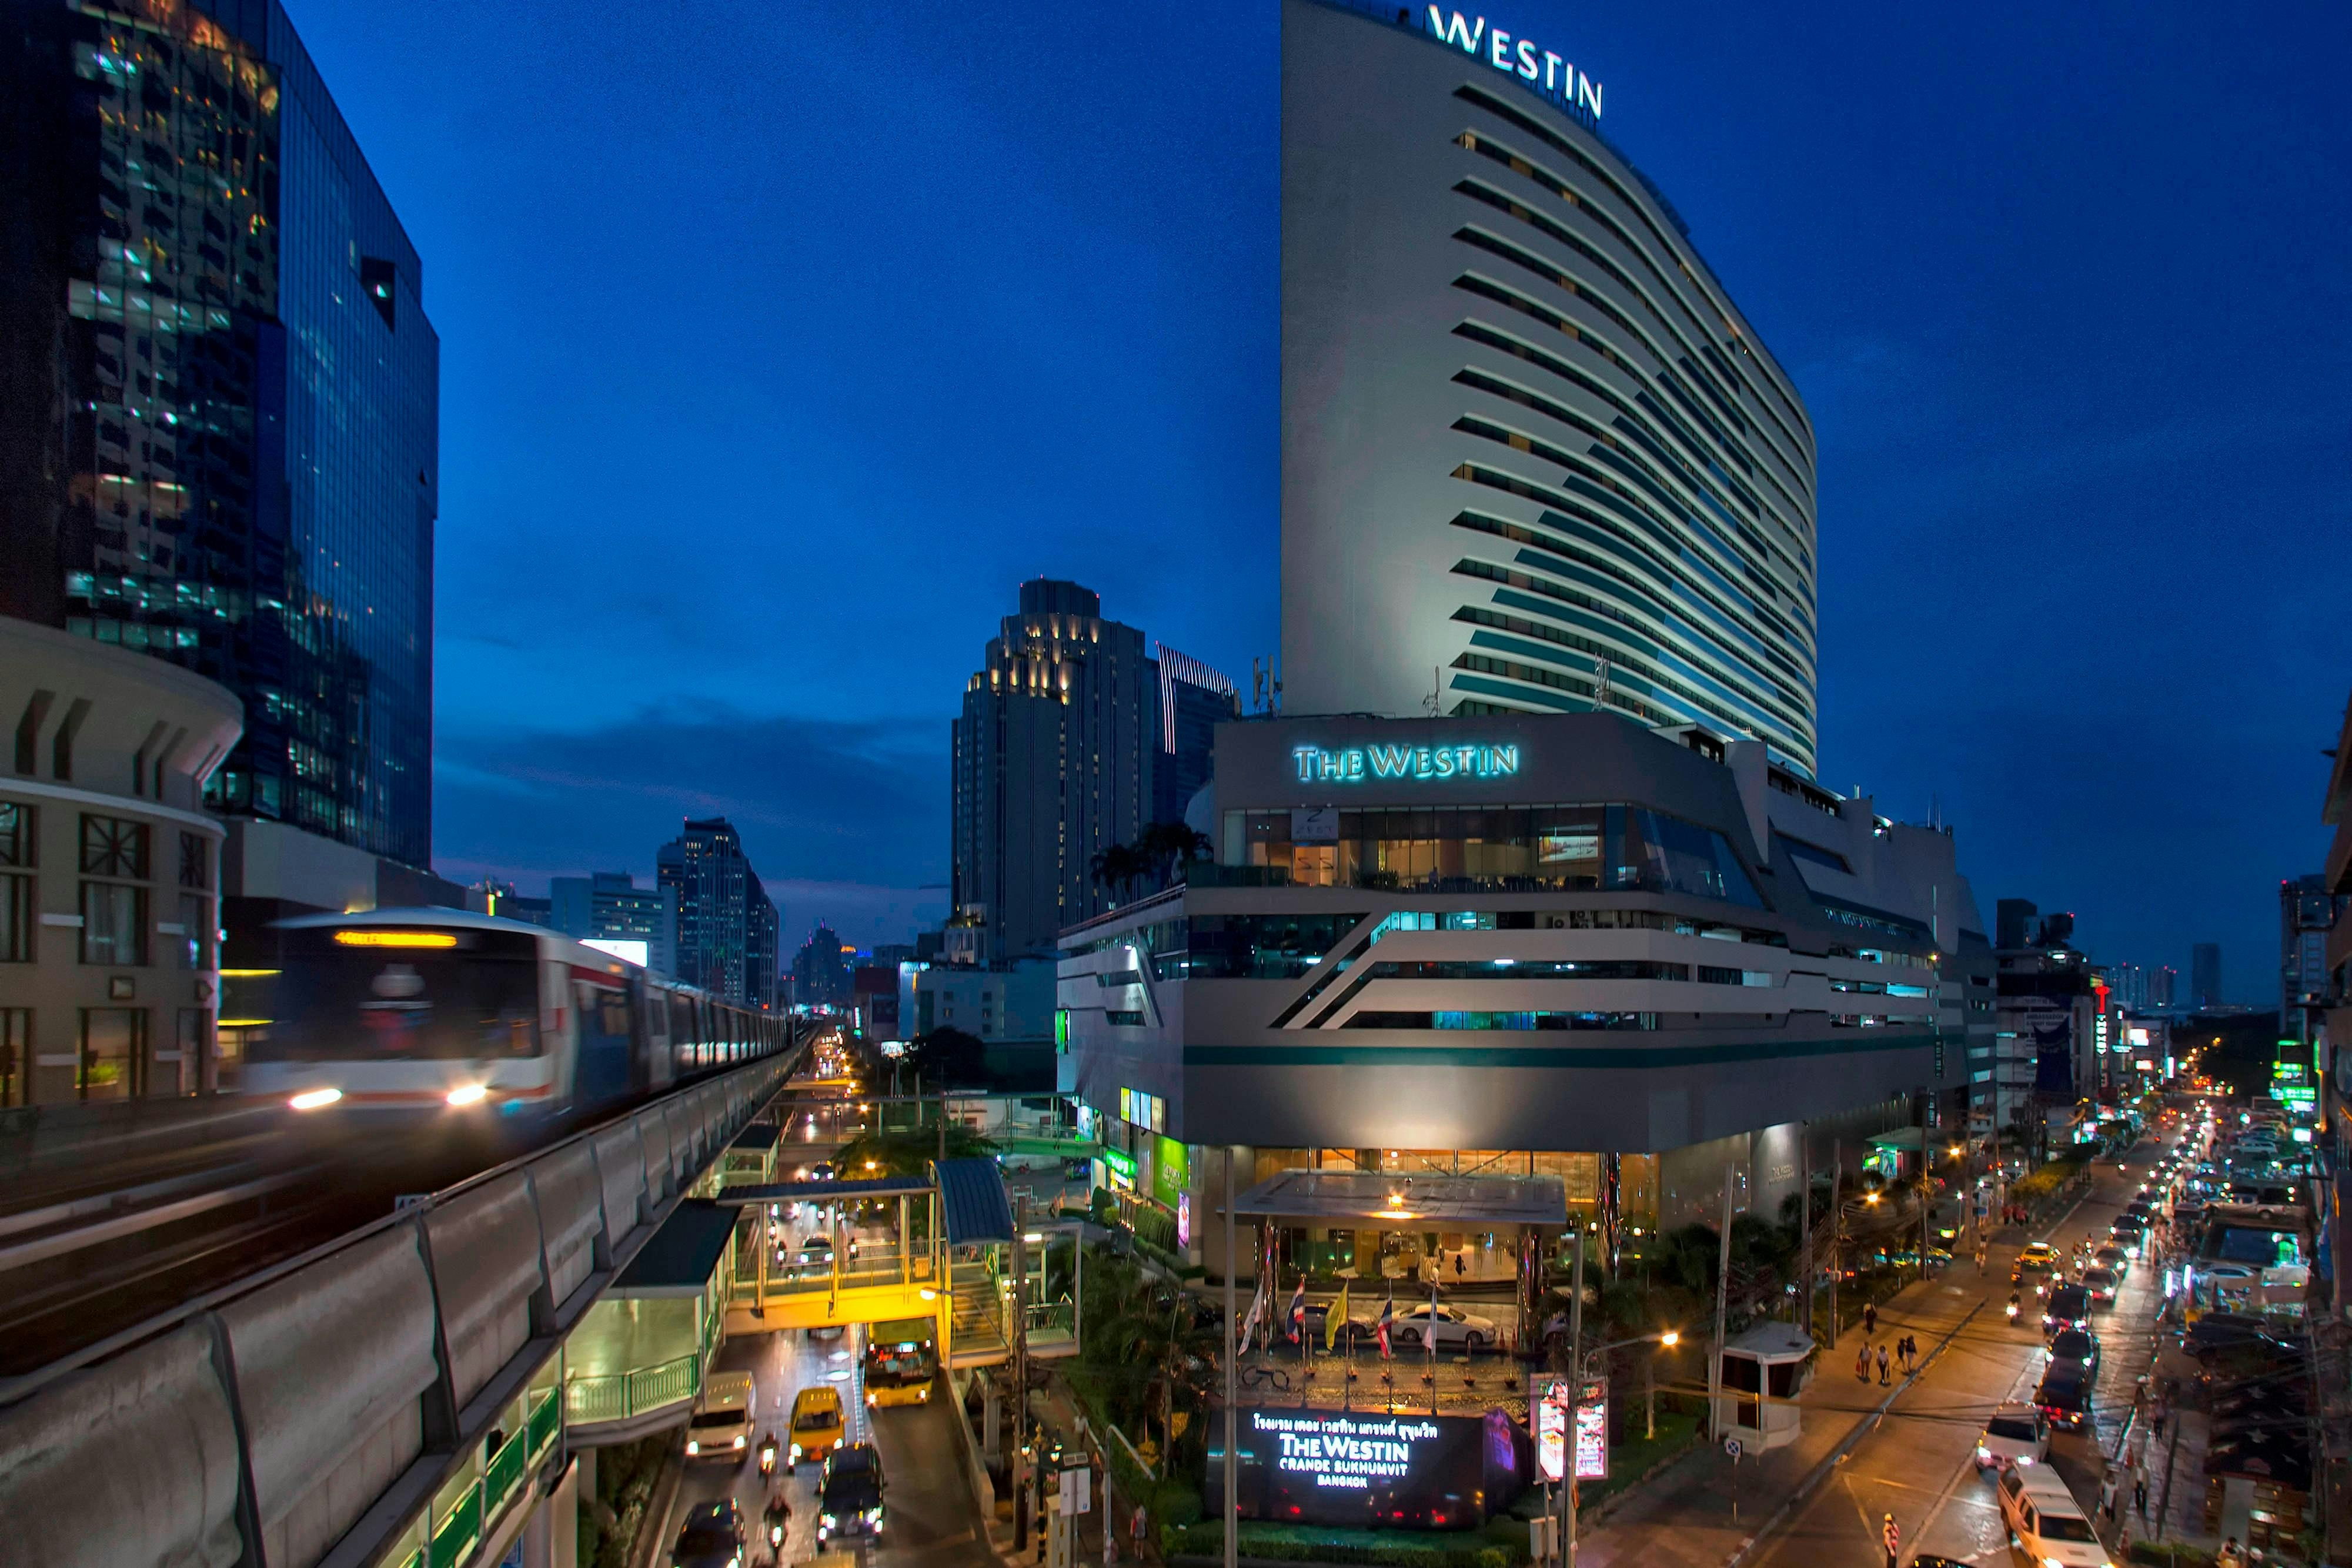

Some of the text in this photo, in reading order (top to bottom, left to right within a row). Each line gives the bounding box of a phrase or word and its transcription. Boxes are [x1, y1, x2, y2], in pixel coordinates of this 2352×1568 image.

[1428, 4, 1603, 120] WESTIN
[1293, 745, 1516, 780] THE WESTIN
[1279, 1433, 1409, 1462] THE WESTIN
[1279, 1457, 1408, 1476] GRANDE SUKHUMVIT
[1317, 1474, 1368, 1488] BANGKOK
